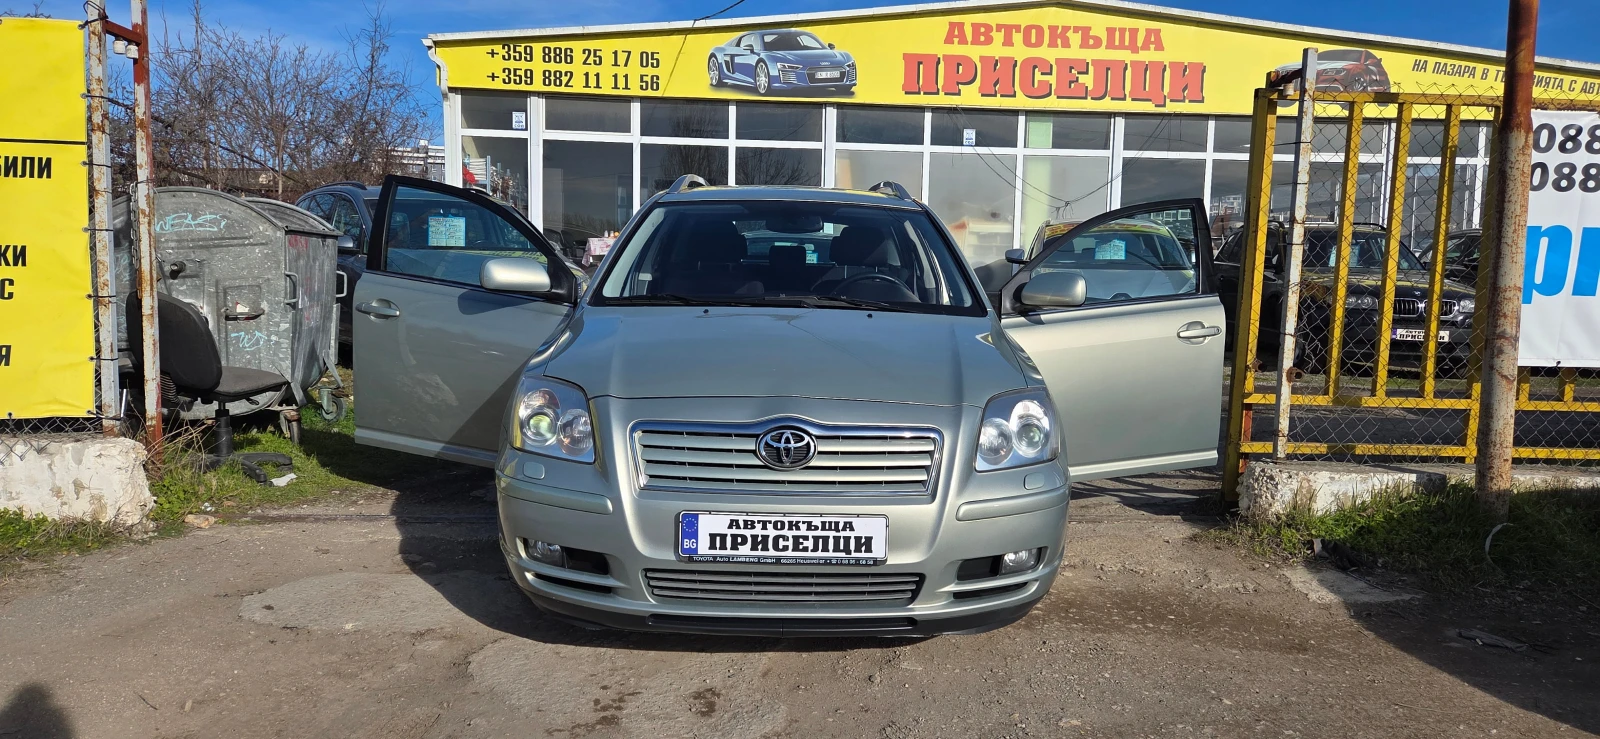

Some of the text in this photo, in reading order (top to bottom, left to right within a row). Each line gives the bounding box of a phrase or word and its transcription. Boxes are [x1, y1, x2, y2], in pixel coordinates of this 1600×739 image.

[943, 21, 1165, 54] АВТОКЪЩА
[486, 43, 660, 69] +359 886 25 17 05
[486, 67, 660, 91] +359 882 11 11 56
[901, 52, 1206, 107] ПРИСЕЛЦИ
[1411, 59, 1428, 73] НА
[1432, 61, 1477, 79] ПАЗАРА
[1480, 67, 1490, 81] В
[1568, 79, 1577, 92] С
[0, 155, 52, 179] ИЛИ
[1529, 161, 1600, 193] 088
[727, 518, 855, 533] АВТОКЪЩА
[683, 538, 697, 549] BG
[708, 532, 874, 555] ПРИСЕЛЦИ
